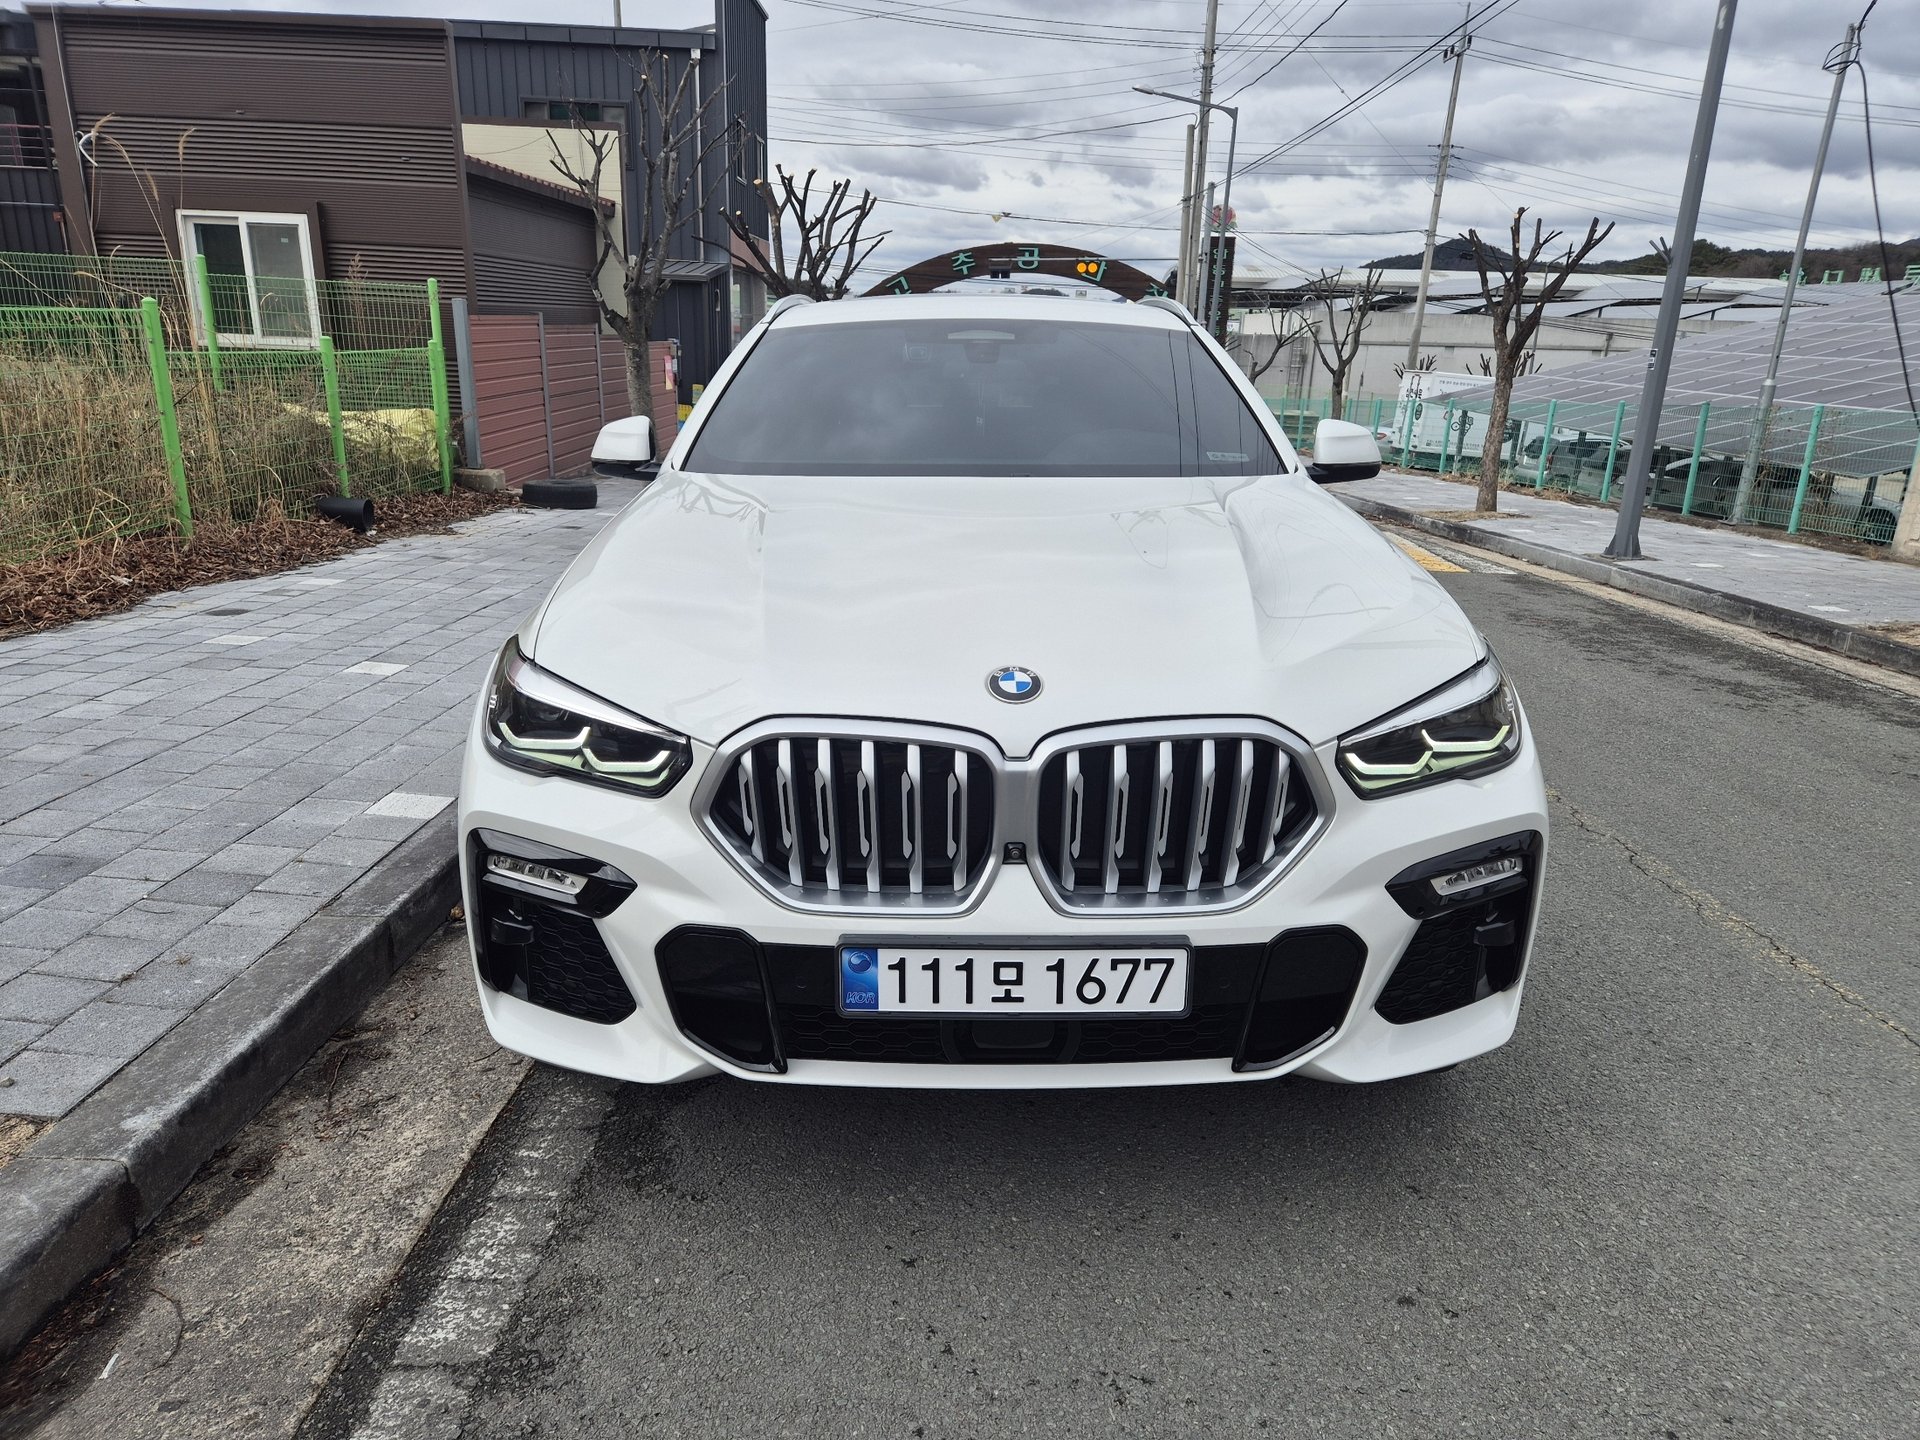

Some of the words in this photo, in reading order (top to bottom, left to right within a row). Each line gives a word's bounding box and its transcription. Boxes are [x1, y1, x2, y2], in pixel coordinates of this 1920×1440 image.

[993, 666, 1037, 677] BMW
[887, 957, 1025, 1004] 111모
[1045, 957, 1175, 1005] 1677
[845, 990, 876, 1004] KOR
